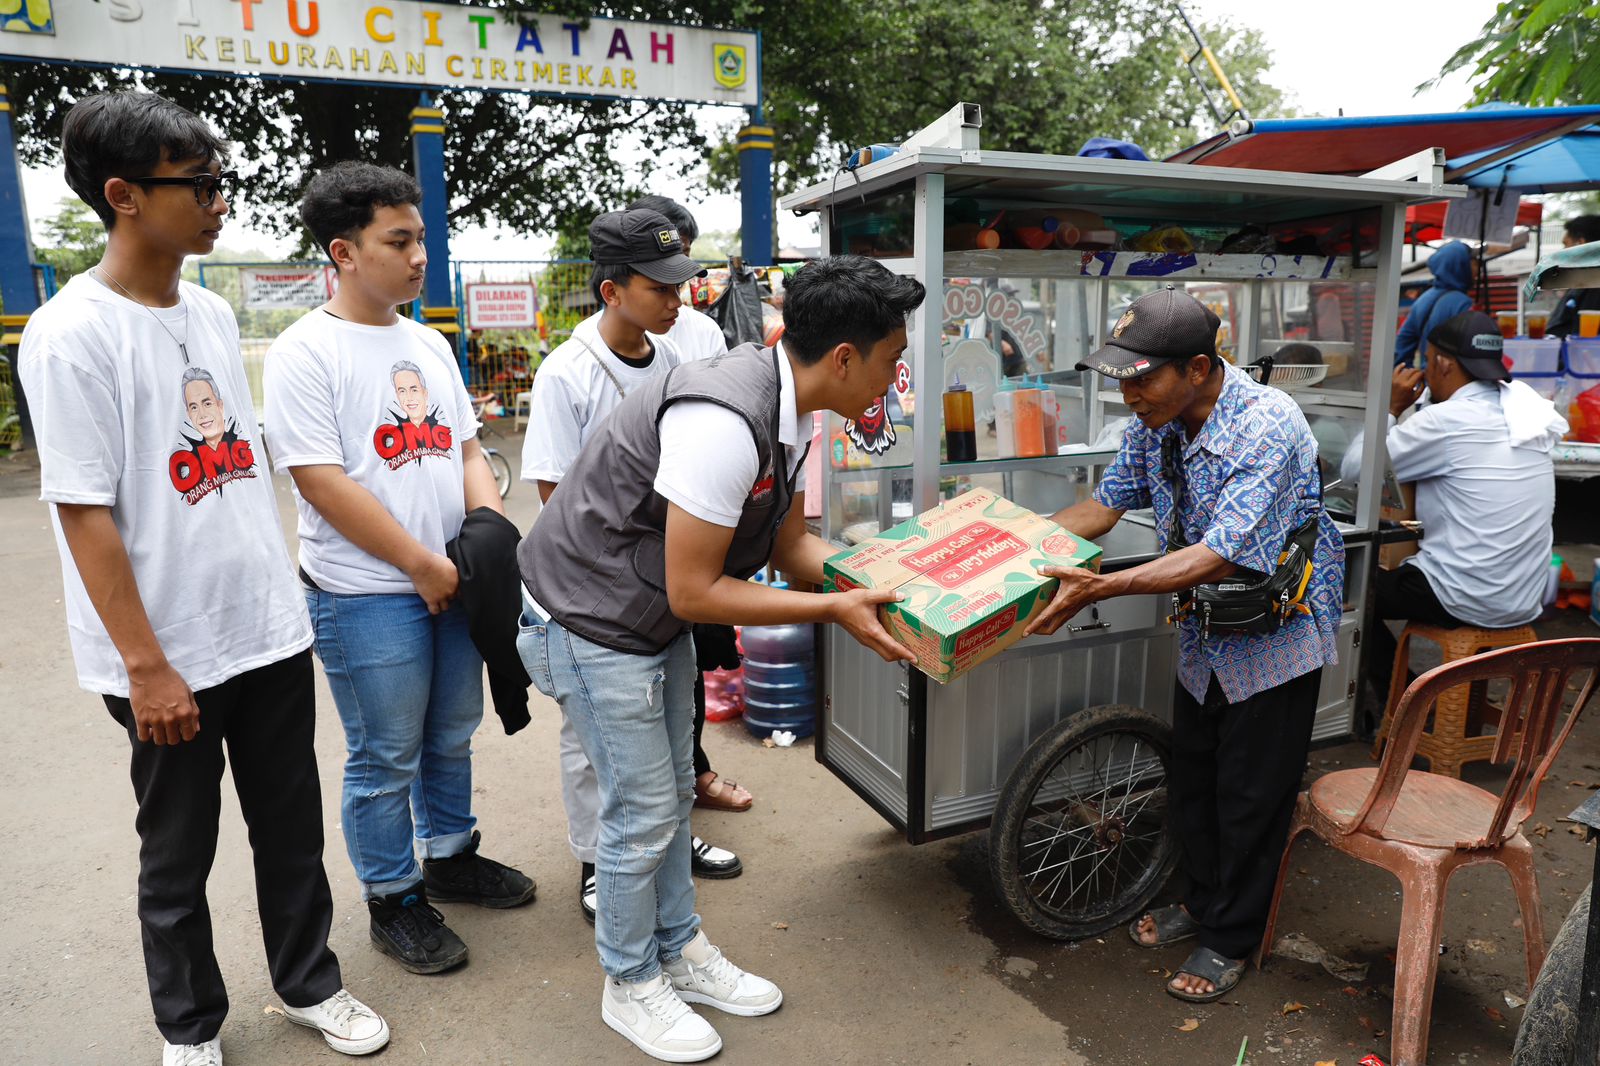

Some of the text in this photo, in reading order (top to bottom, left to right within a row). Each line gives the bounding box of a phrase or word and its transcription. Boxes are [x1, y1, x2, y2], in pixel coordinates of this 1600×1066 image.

[364, 6, 674, 64] CITATAH
[185, 34, 638, 89] KELURAHAN CIRIMEKAR
[475, 290, 527, 301] DILARANG
[372, 422, 453, 460] OMG
[169, 440, 255, 494] OMG
[387, 450, 415, 471] ORANG
[185, 478, 214, 505] ORANG
[213, 470, 235, 486] MUDA
[947, 591, 1003, 622] Automatic
